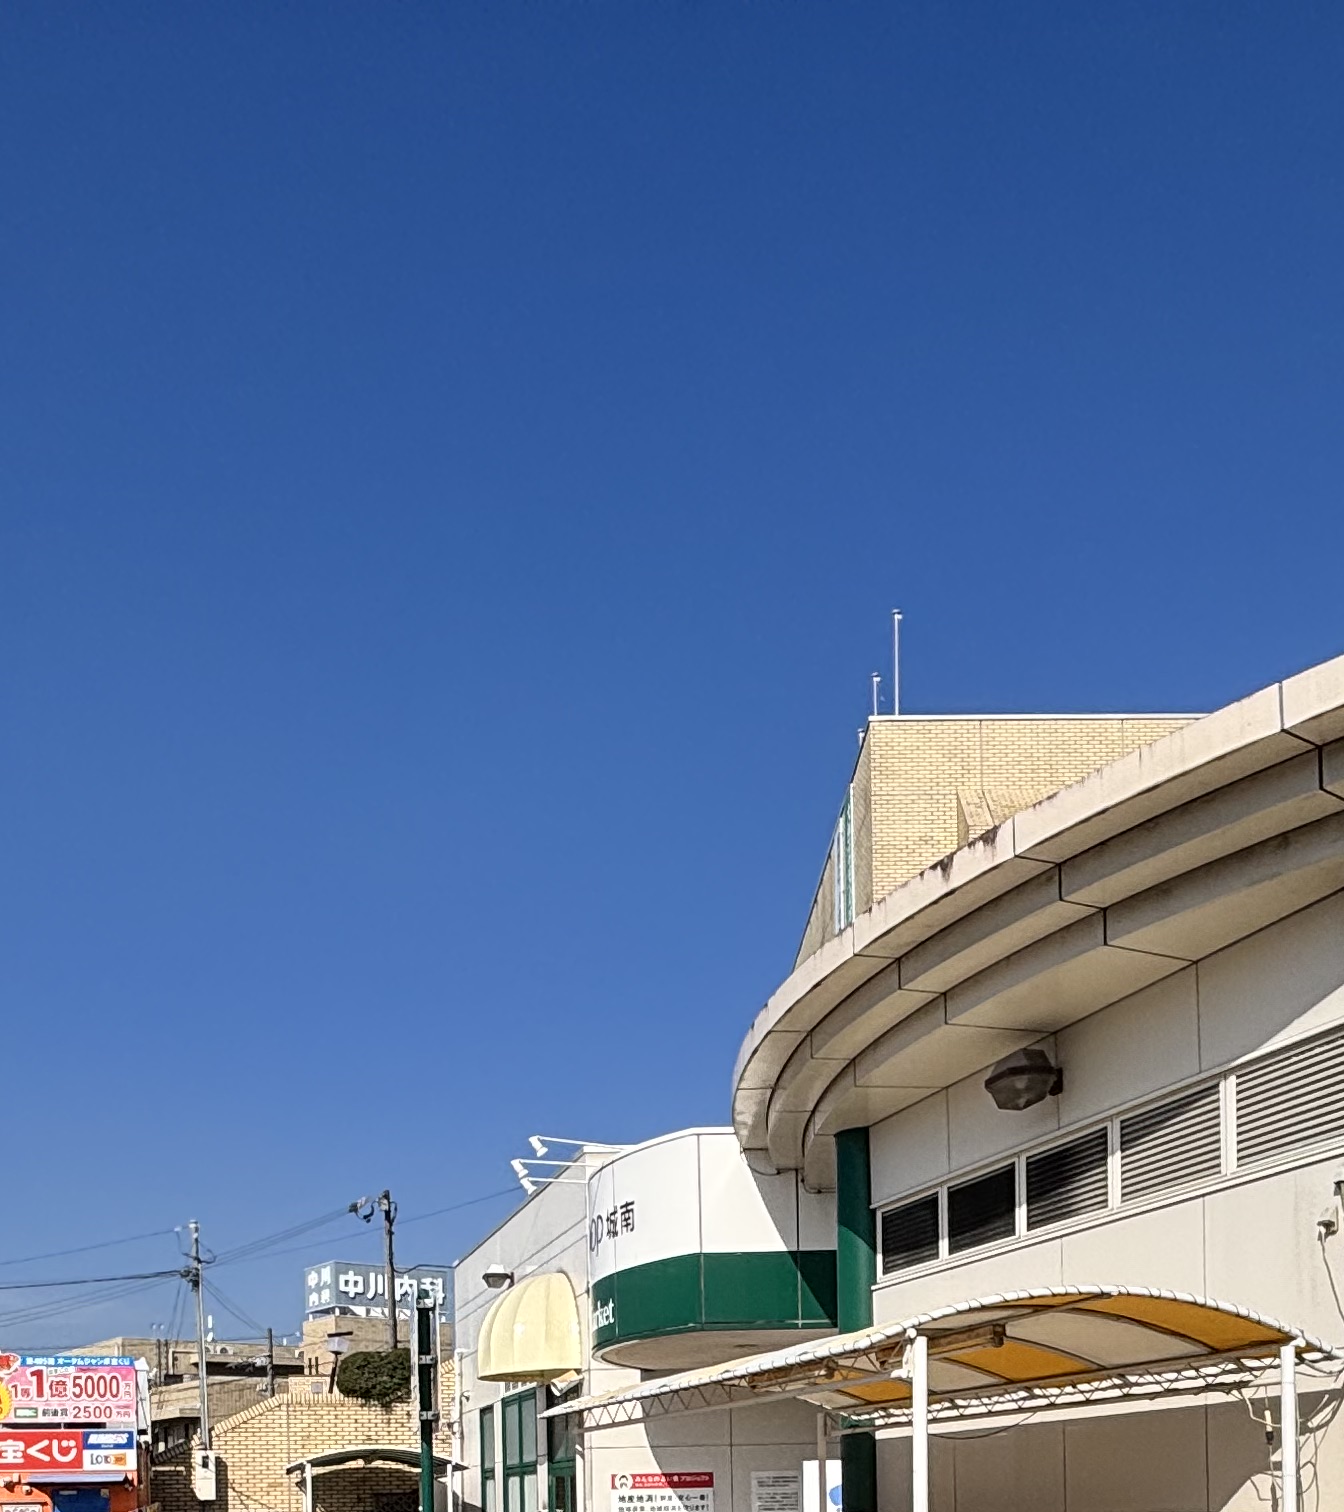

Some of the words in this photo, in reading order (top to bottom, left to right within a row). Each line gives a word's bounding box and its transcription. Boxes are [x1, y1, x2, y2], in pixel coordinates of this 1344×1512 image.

[606, 1200, 635, 1240] 城南
[338, 1270, 446, 1305] 中川内科
